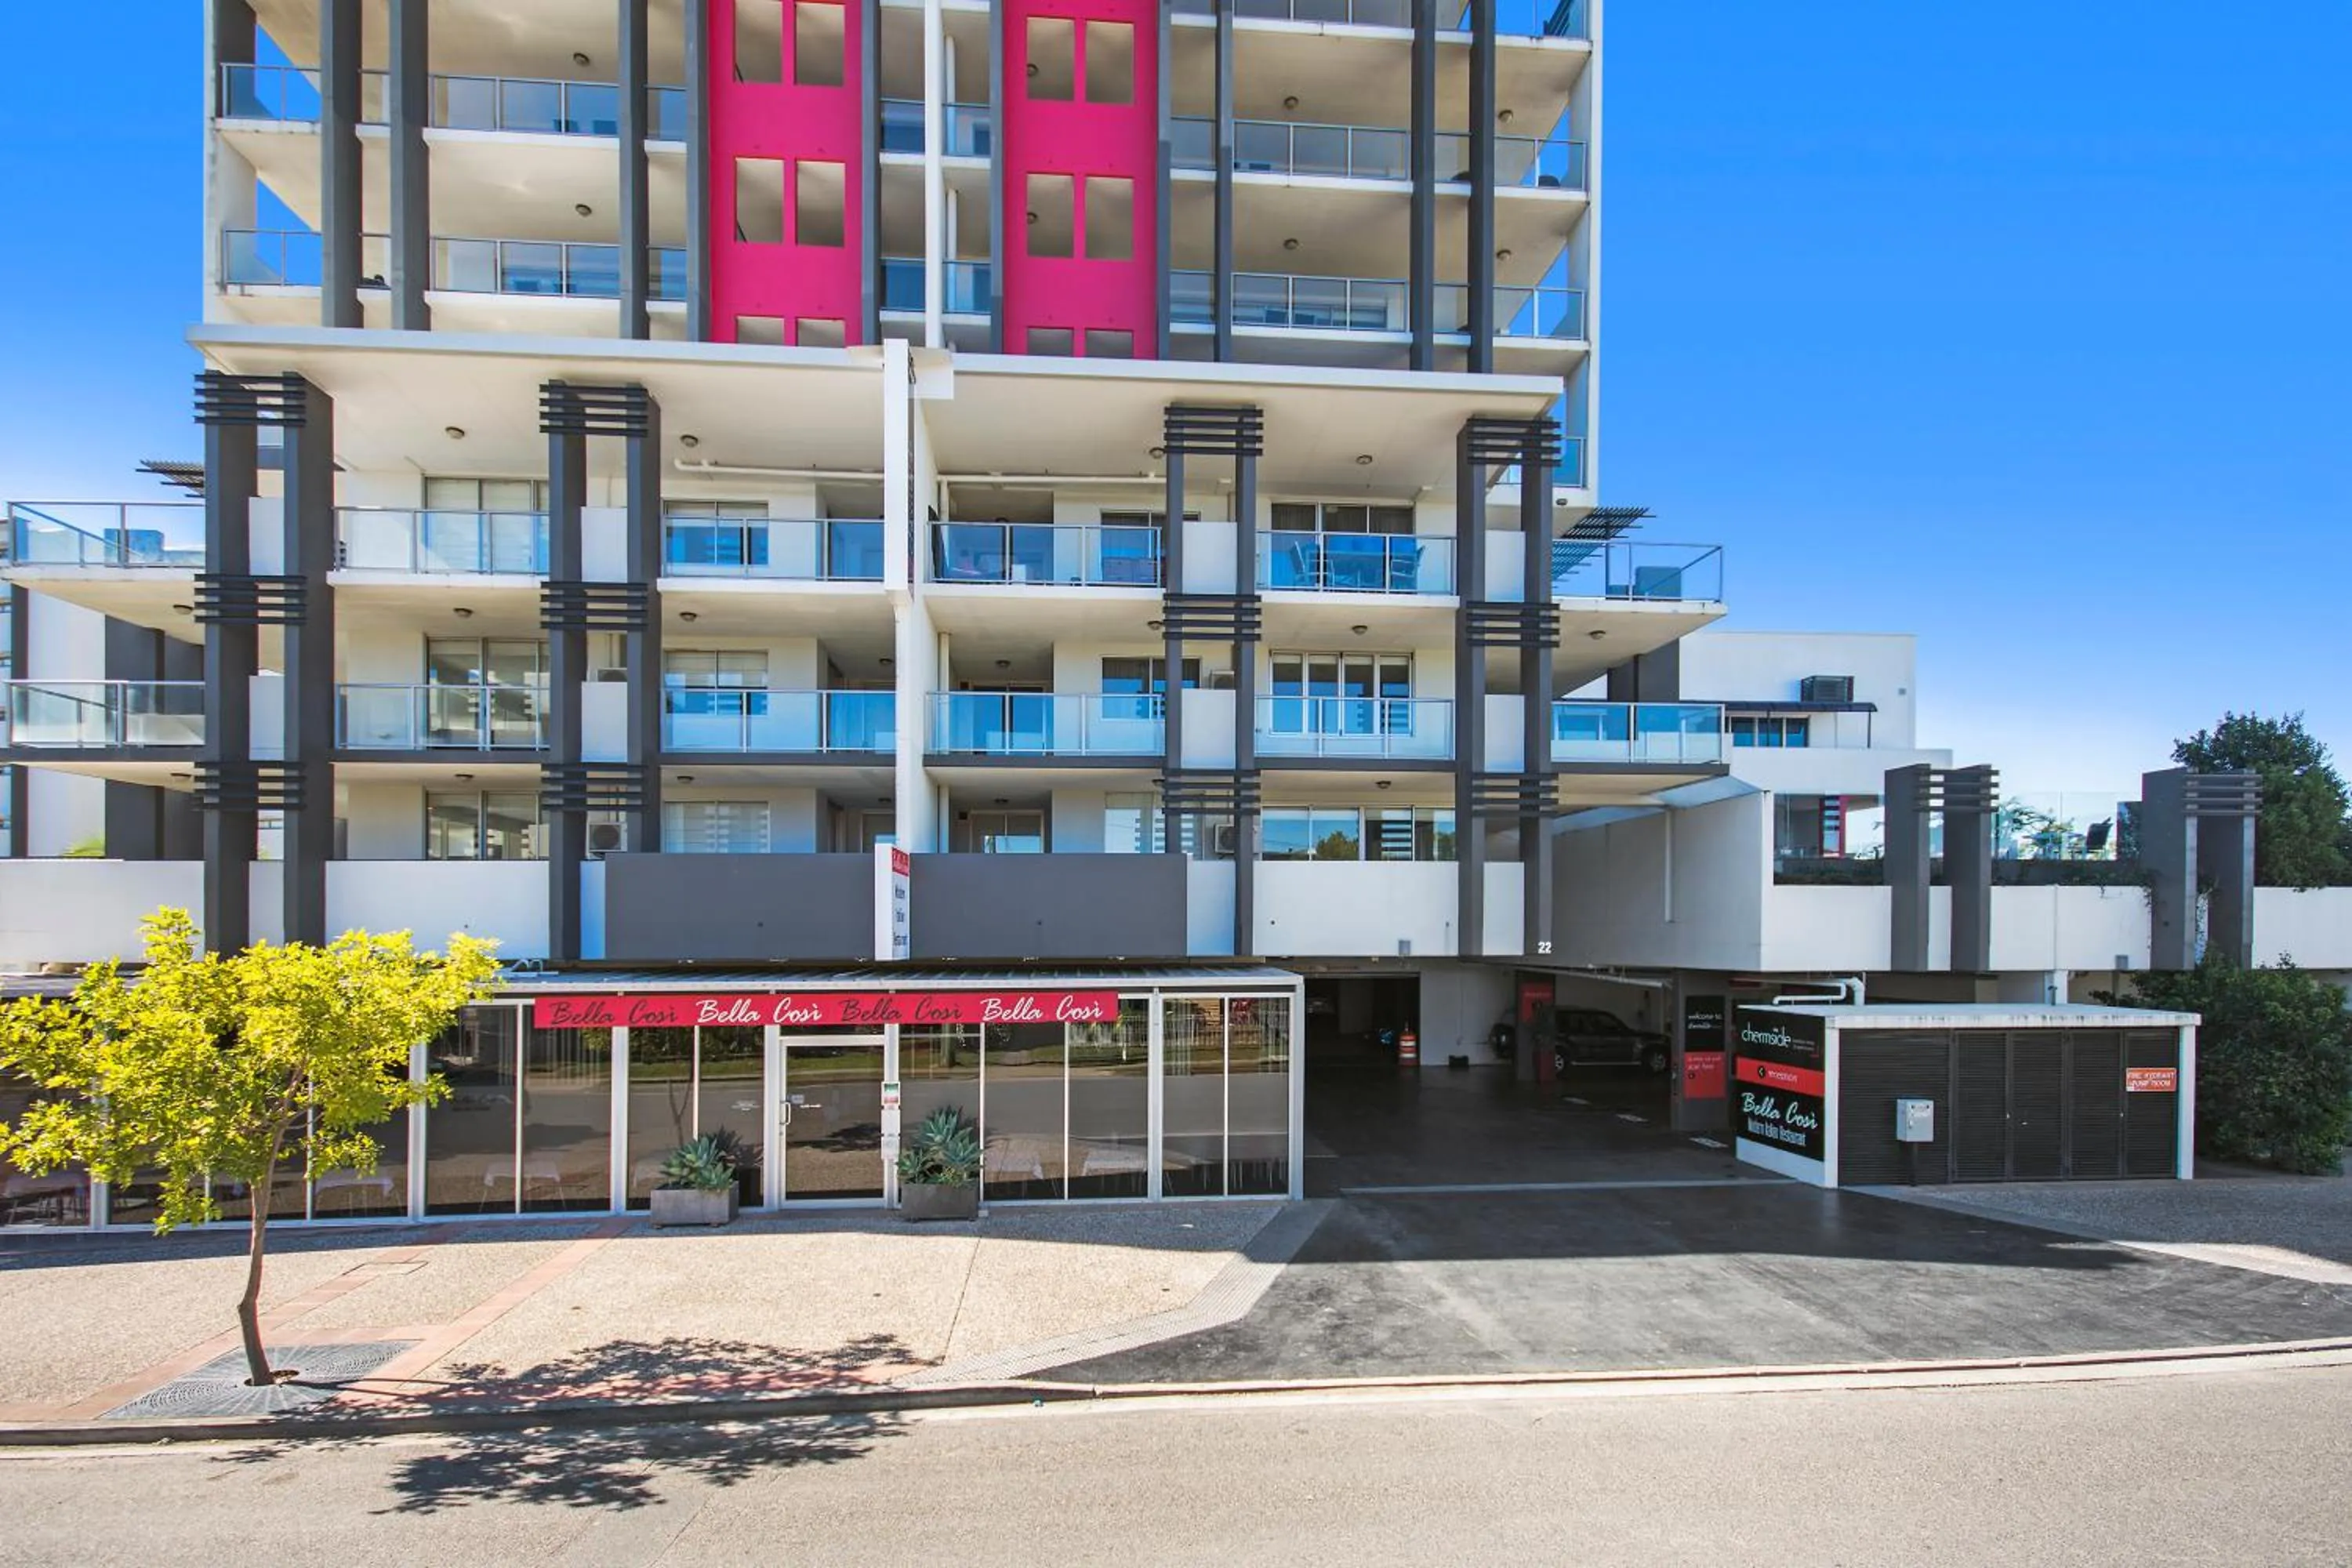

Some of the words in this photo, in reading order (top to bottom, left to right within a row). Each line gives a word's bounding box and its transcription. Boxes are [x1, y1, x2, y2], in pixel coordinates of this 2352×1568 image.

[1537, 941, 1552, 953] 22
[550, 1000, 616, 1025] Bella
[629, 998, 678, 1025] Così
[695, 997, 761, 1024] Bella
[772, 996, 822, 1023] Così
[840, 997, 902, 1022] Bella
[914, 996, 963, 1021] Così
[980, 996, 1044, 1021] Bella
[1055, 994, 1103, 1021] Così
[1741, 1021, 1792, 1047] chermside
[1741, 1092, 1780, 1120] Bella
